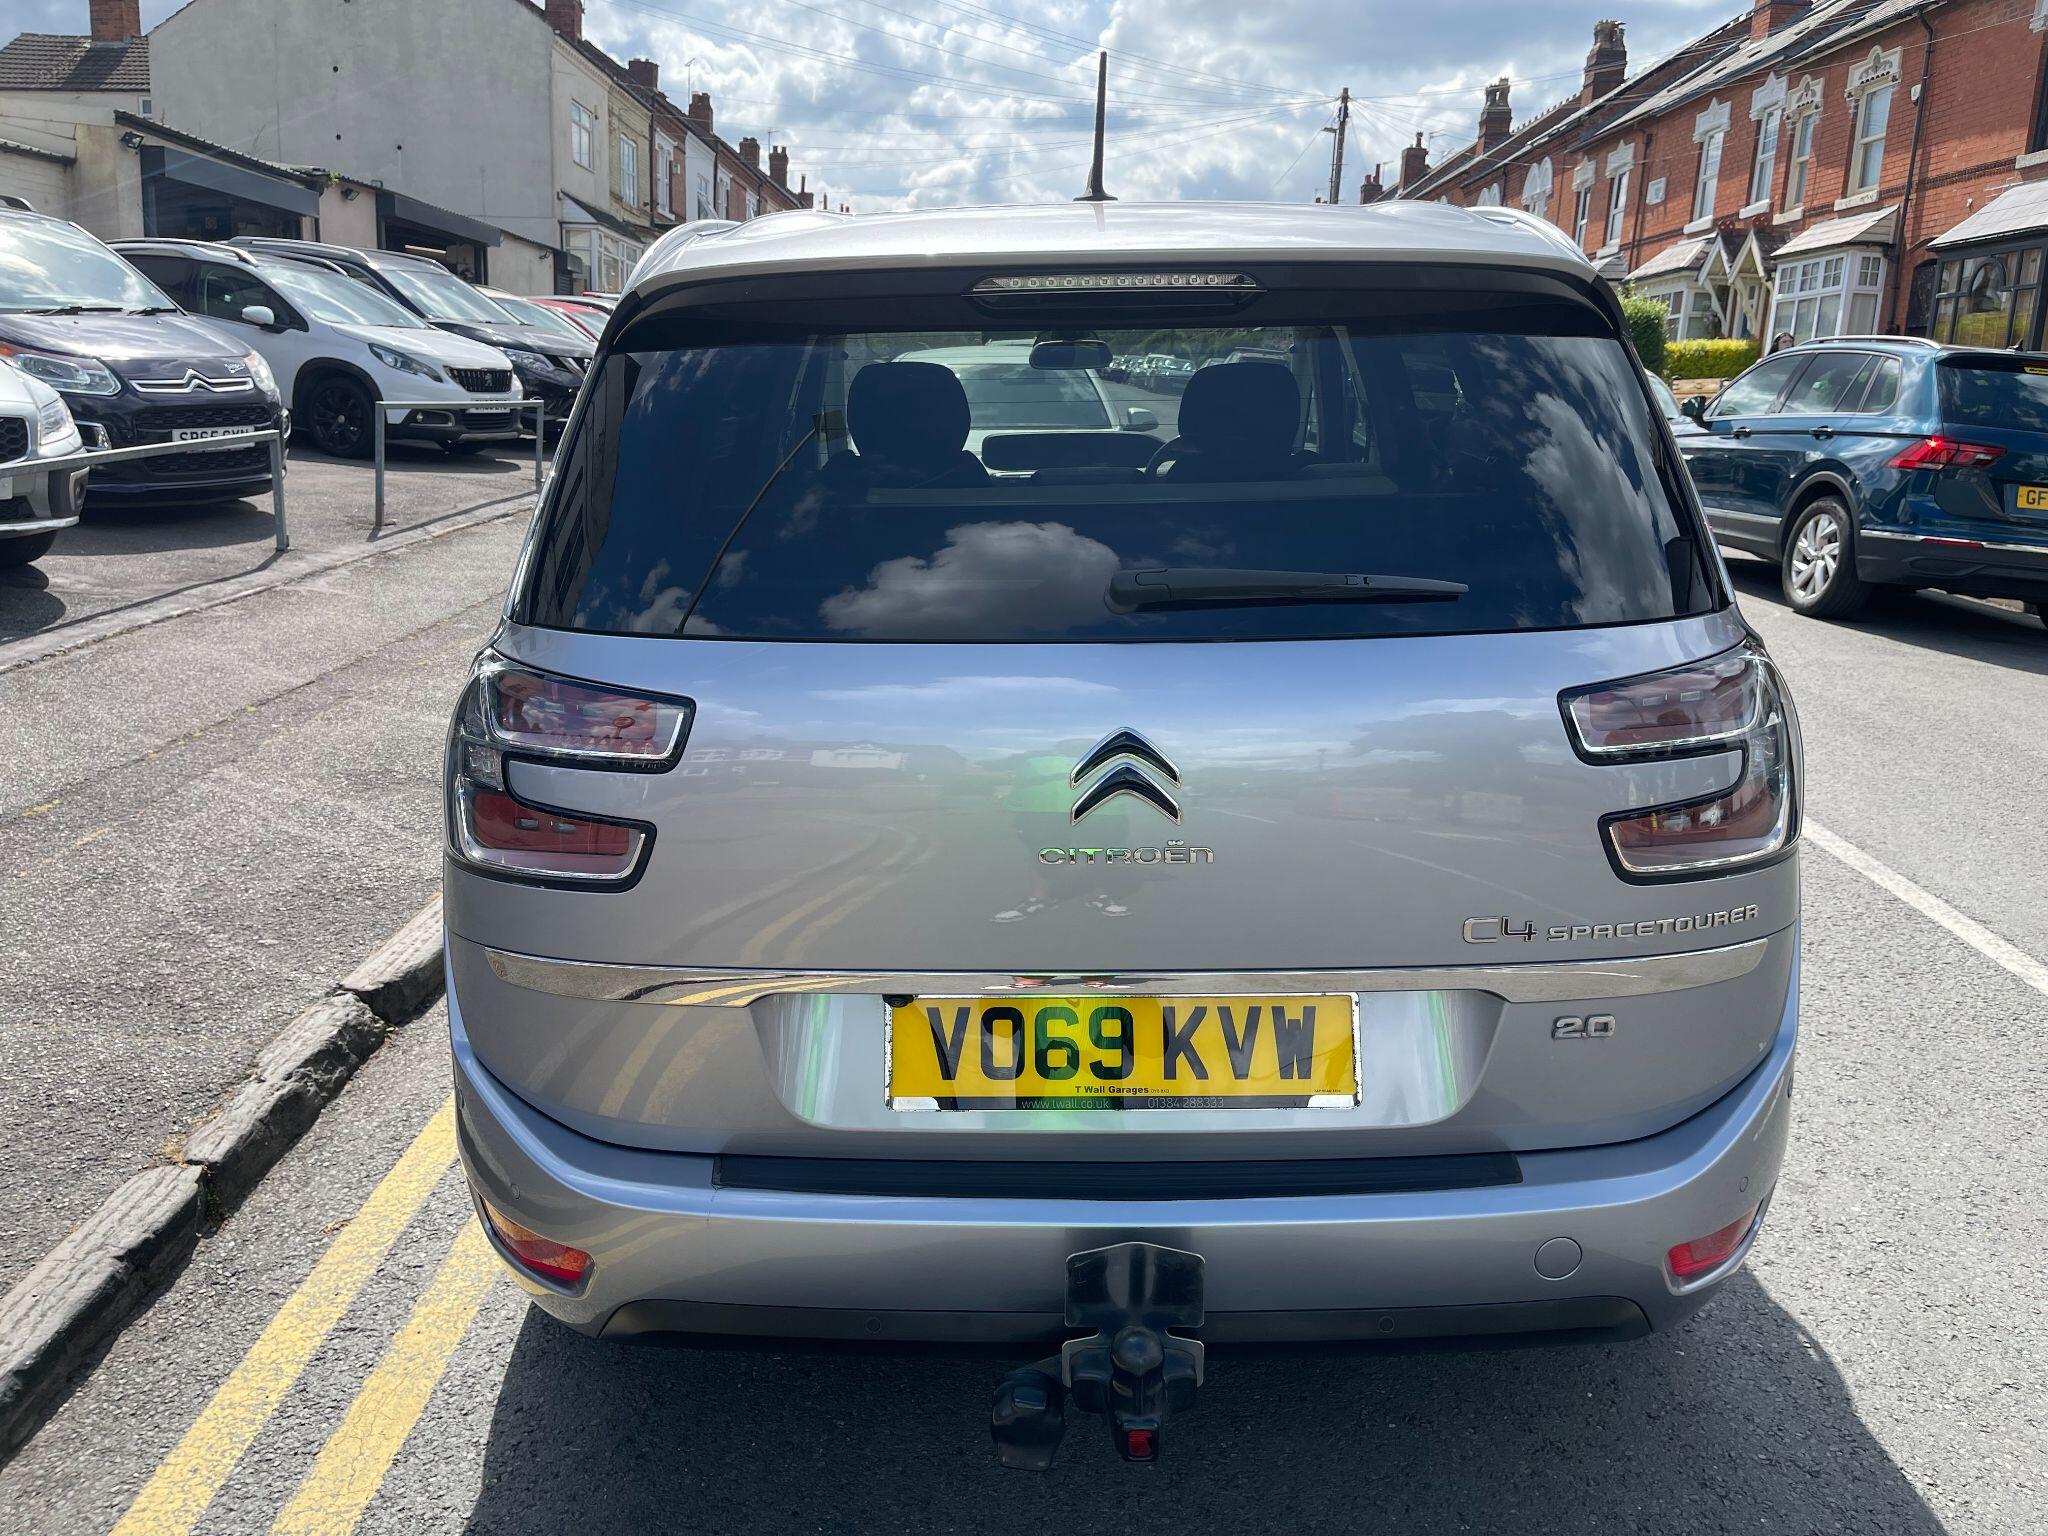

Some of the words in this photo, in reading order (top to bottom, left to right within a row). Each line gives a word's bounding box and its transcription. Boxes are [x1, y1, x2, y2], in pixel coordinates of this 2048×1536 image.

[1462, 916, 1537, 944] C4
[1546, 904, 1760, 941] SPACETOURER
[925, 1006, 1135, 1081] VO69
[1162, 1006, 1316, 1080] KVW
[1021, 1097, 1110, 1109] www.twall.co.uk
[1147, 1097, 1180, 1109] 01384
[1075, 1086, 1081, 1094] T
[1084, 1085, 1105, 1094] Wall
[1108, 1085, 1149, 1096] Garages
